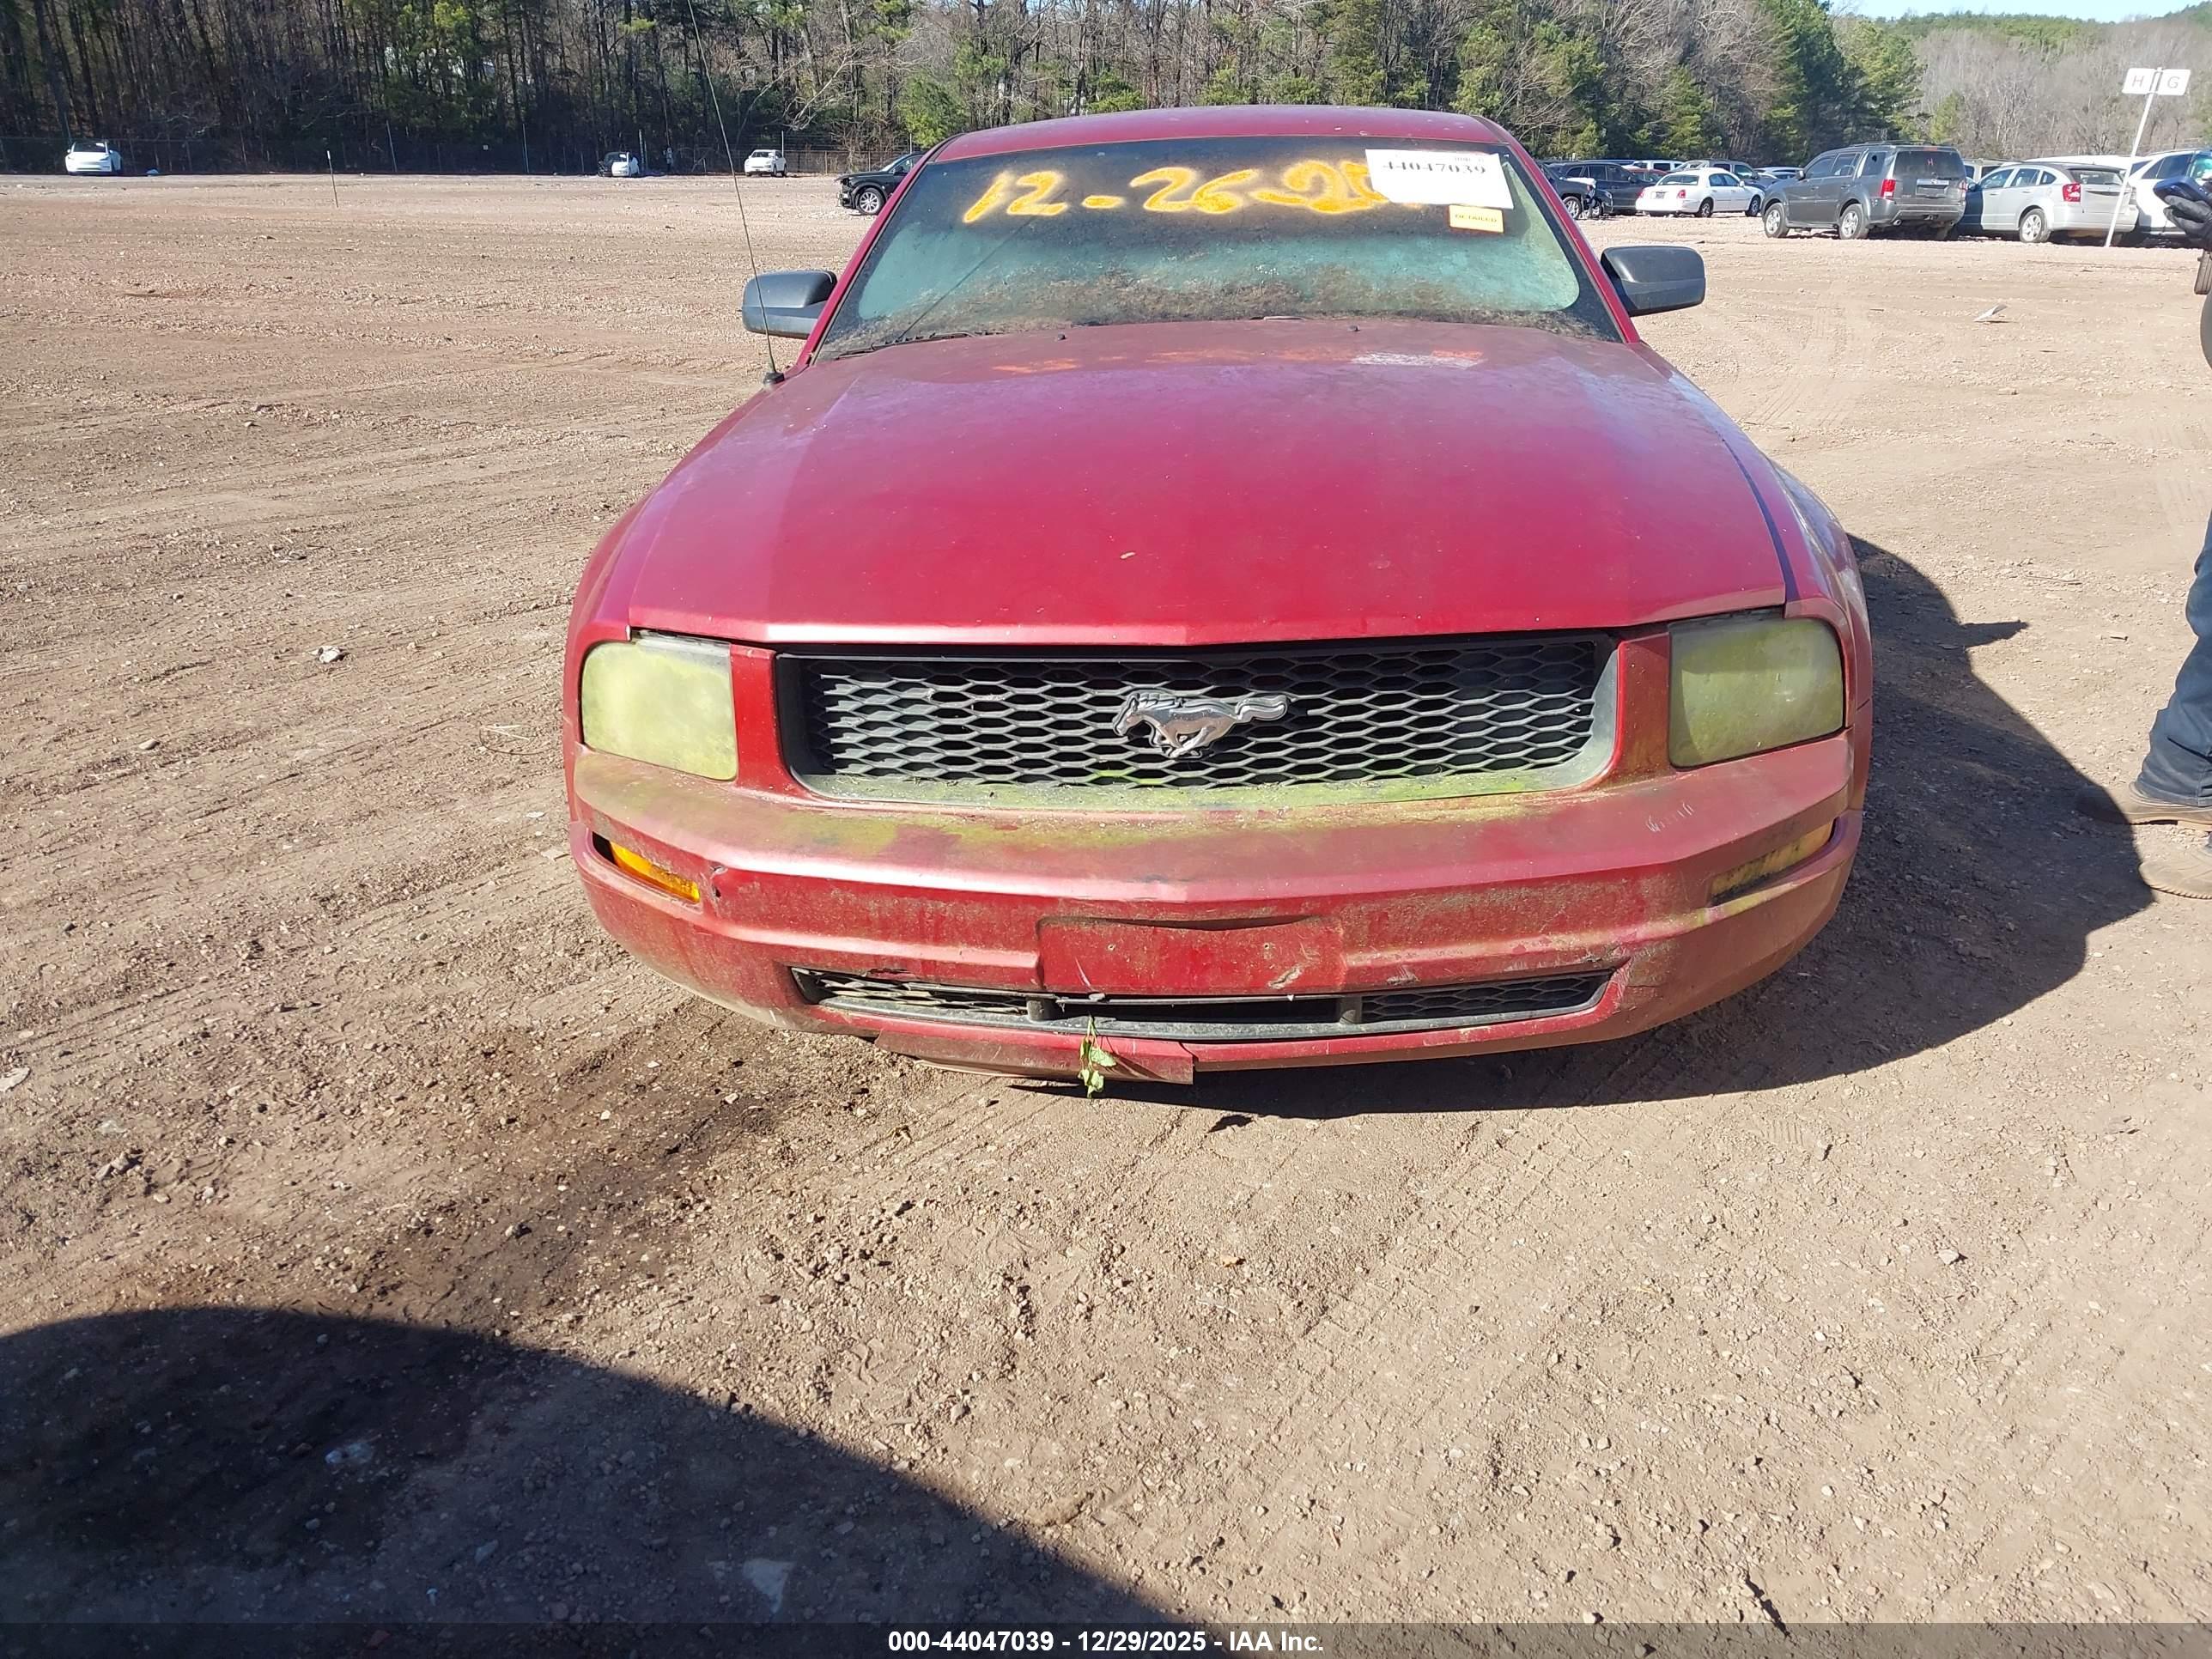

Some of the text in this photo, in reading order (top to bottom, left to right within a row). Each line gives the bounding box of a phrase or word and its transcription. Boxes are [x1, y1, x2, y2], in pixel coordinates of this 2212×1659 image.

[2131, 75, 2145, 88] H
[2166, 76, 2181, 89] G
[1382, 161, 1486, 173] 44047039
